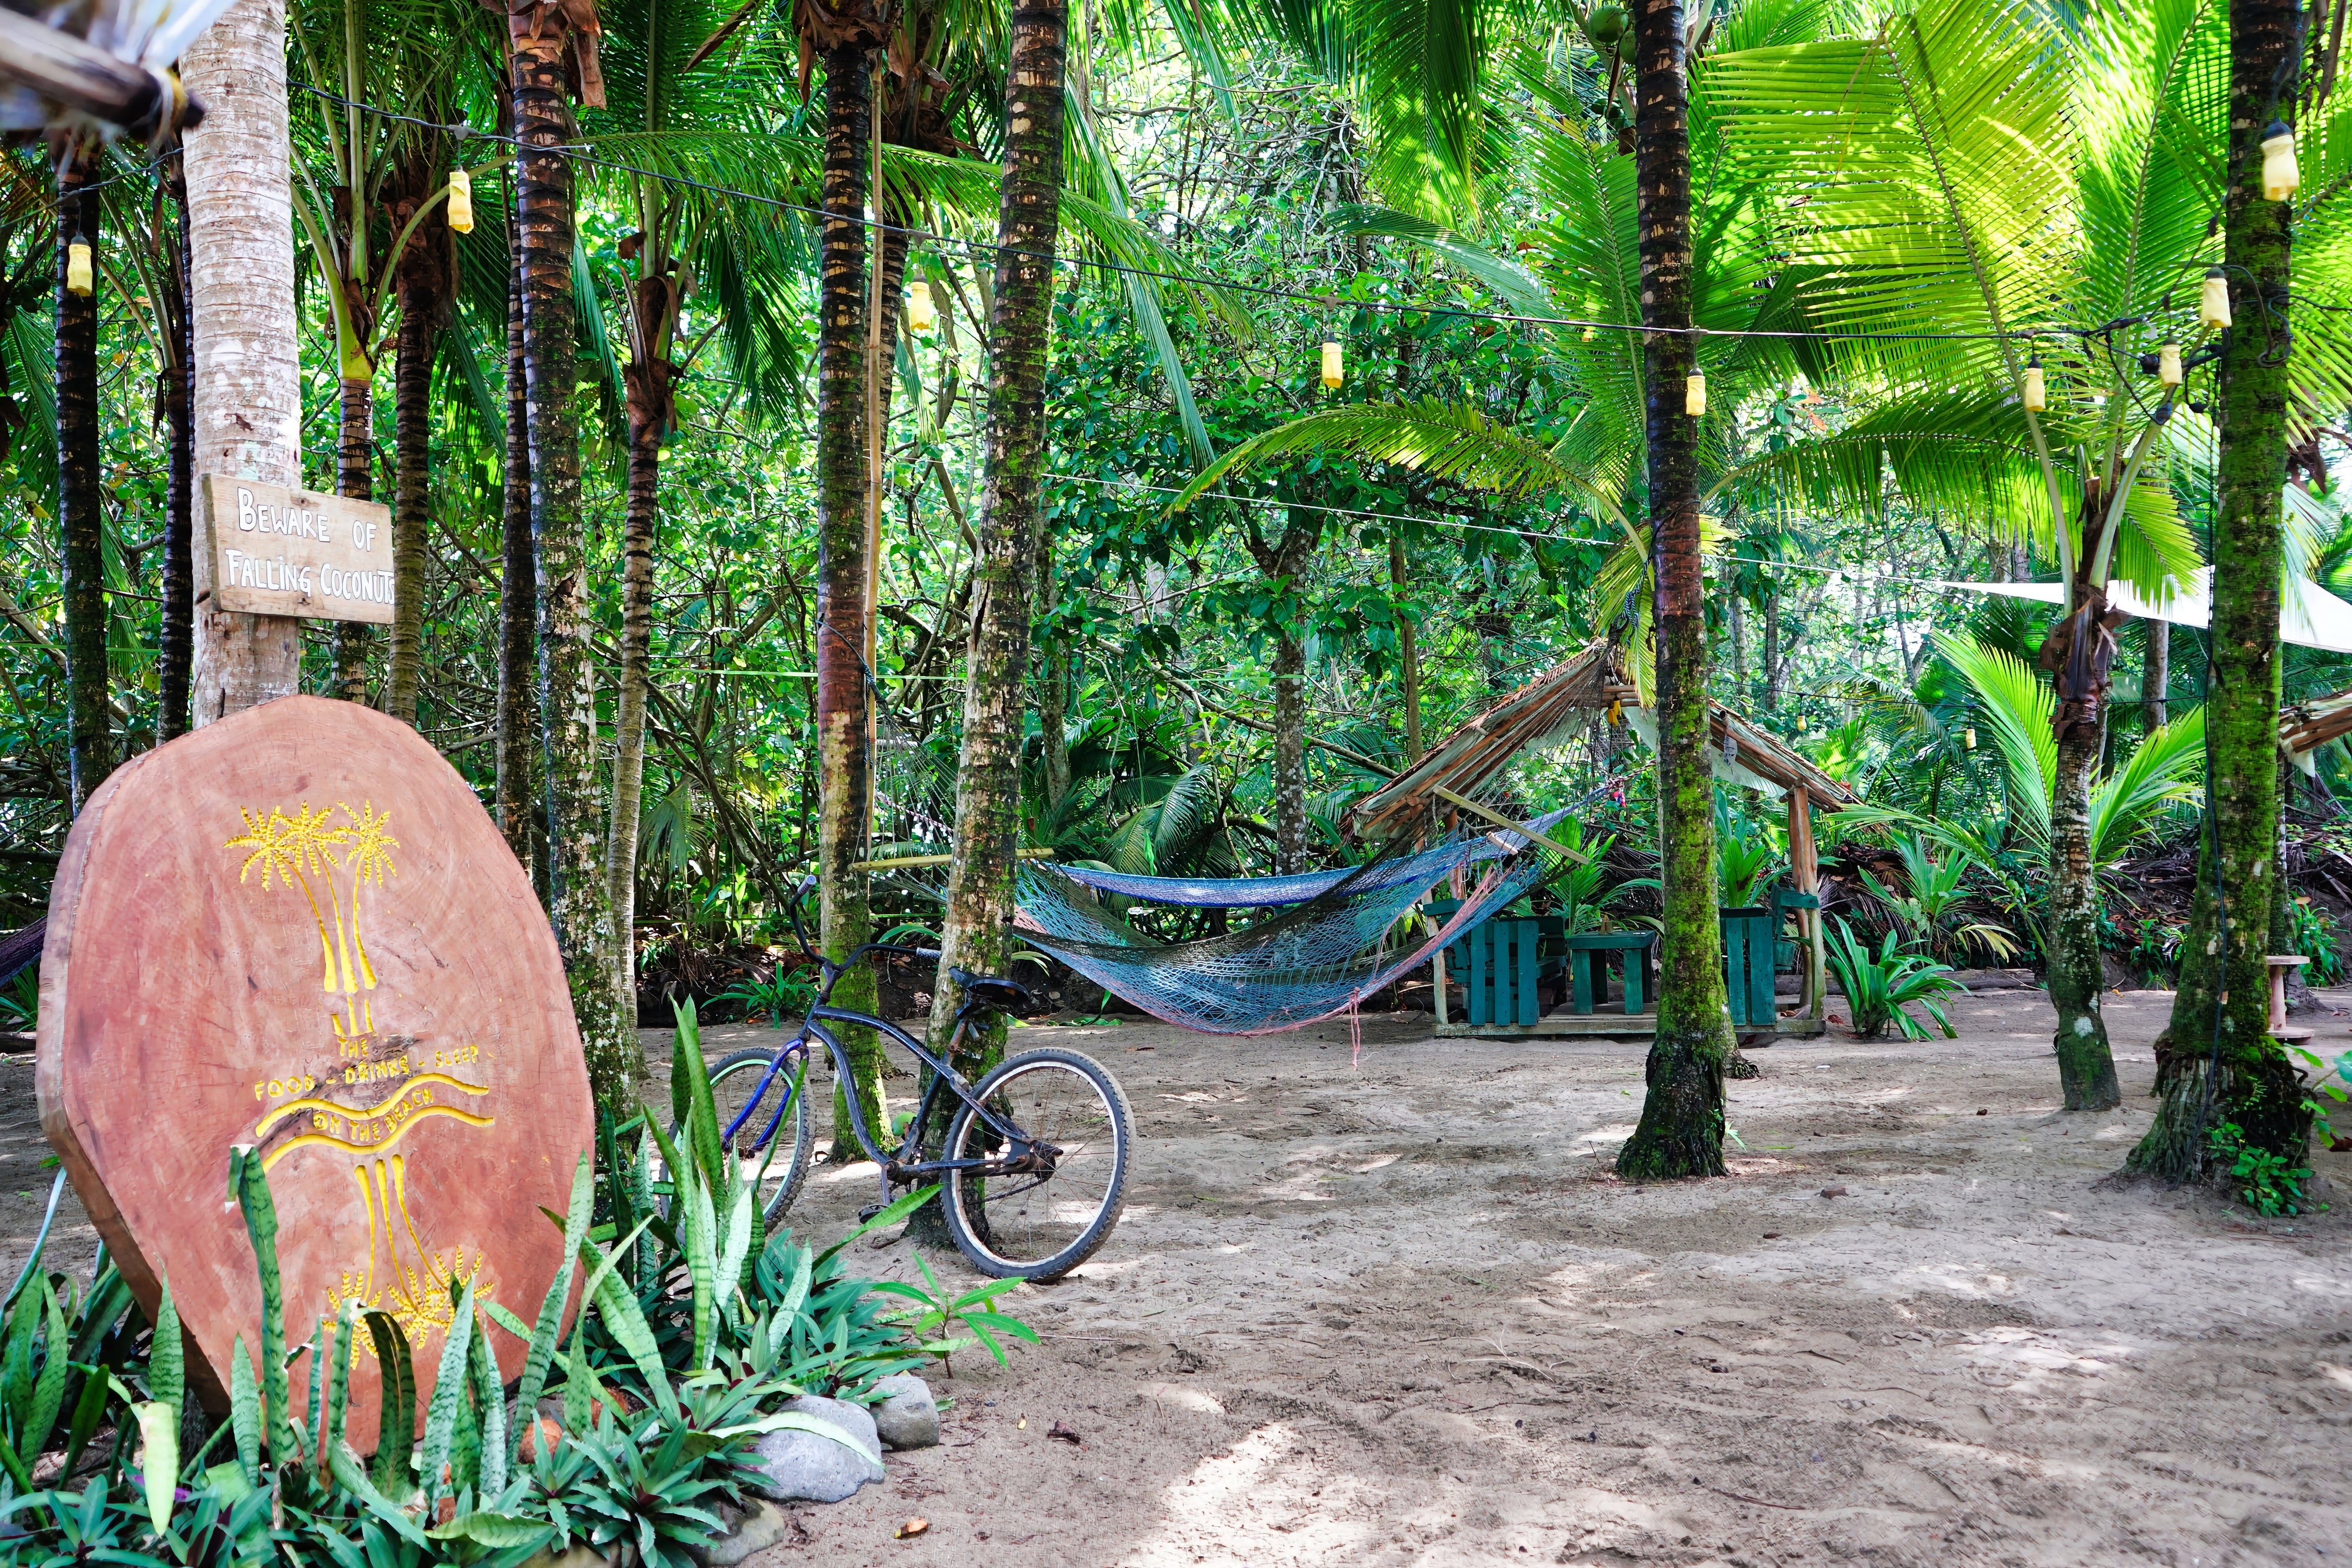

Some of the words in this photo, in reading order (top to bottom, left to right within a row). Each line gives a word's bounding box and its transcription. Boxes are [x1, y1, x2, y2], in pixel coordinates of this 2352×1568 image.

[352, 521, 377, 551] OF
[338, 1037, 368, 1058] THE
[255, 1074, 315, 1101] FOOD
[345, 1055, 411, 1084] DRINKS
[435, 1045, 479, 1068] SLEEP
[313, 1112, 341, 1134] ON
[349, 1121, 381, 1142] THE
[385, 1088, 434, 1133] BEACH
